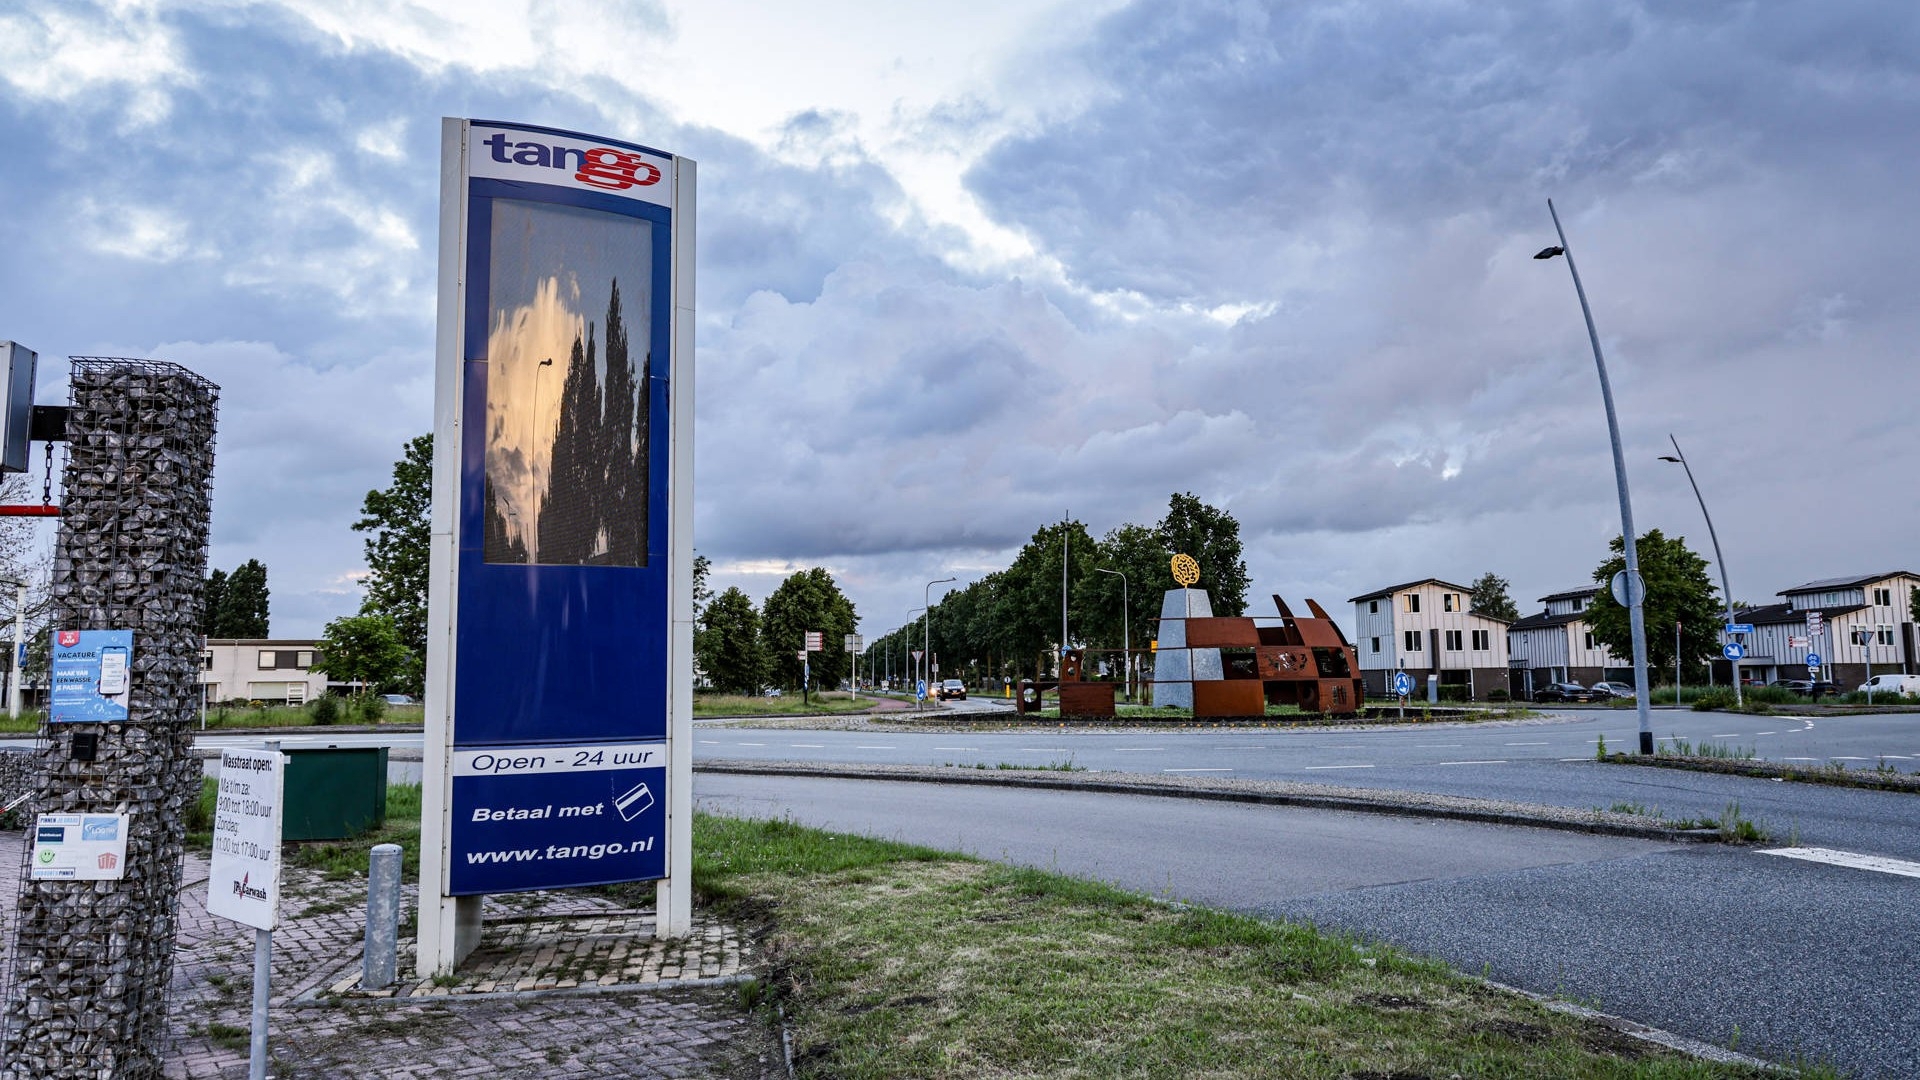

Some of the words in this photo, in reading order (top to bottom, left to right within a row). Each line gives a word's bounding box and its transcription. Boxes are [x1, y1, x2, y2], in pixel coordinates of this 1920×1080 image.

[483, 133, 662, 191] tango
[222, 753, 252, 770] Wasstraat
[252, 757, 272, 774] open:
[472, 754, 545, 774] Open
[572, 750, 604, 767] 24
[613, 750, 653, 765] uur
[220, 778, 229, 794] Ma
[241, 783, 250, 796] za:
[218, 796, 231, 812] 9:00
[231, 799, 241, 814] tot
[242, 800, 259, 817] 18:00
[260, 806, 272, 818] uur
[471, 805, 552, 822] Betaal
[557, 802, 604, 818] met
[216, 815, 239, 836] Zondag:
[215, 837, 231, 852] 11:00
[231, 840, 239, 855] tot
[241, 841, 258, 859] 17:00
[259, 849, 271, 861] uur
[466, 836, 654, 864] www.tango.nl
[242, 883, 267, 899] Carwash
